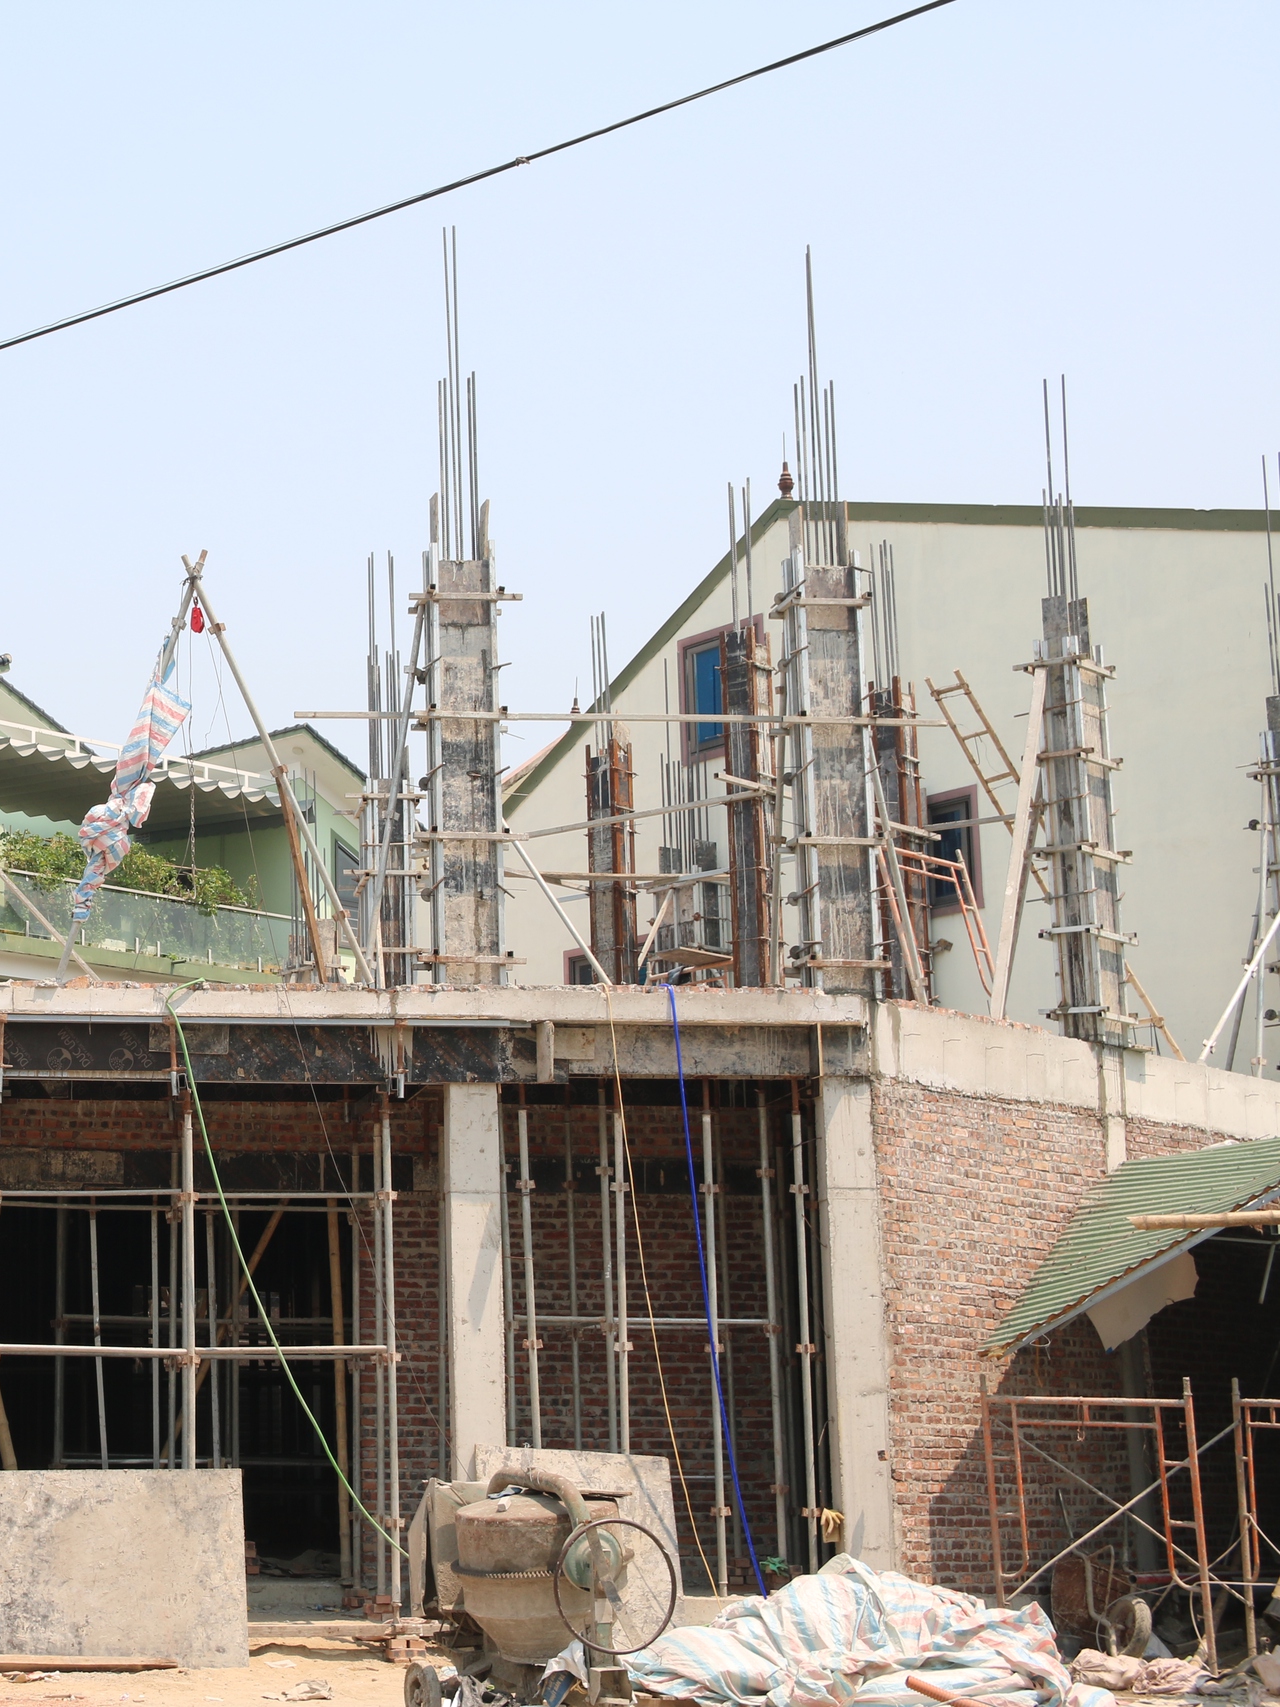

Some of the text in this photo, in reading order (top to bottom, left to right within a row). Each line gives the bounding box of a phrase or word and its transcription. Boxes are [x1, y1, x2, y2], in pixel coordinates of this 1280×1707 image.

[56, 1028, 76, 1050] LAM
[118, 1028, 138, 1051] LAM
[9, 1045, 29, 1067] DUC
[71, 1046, 91, 1068] DUC
[133, 1046, 153, 1068] DUC
